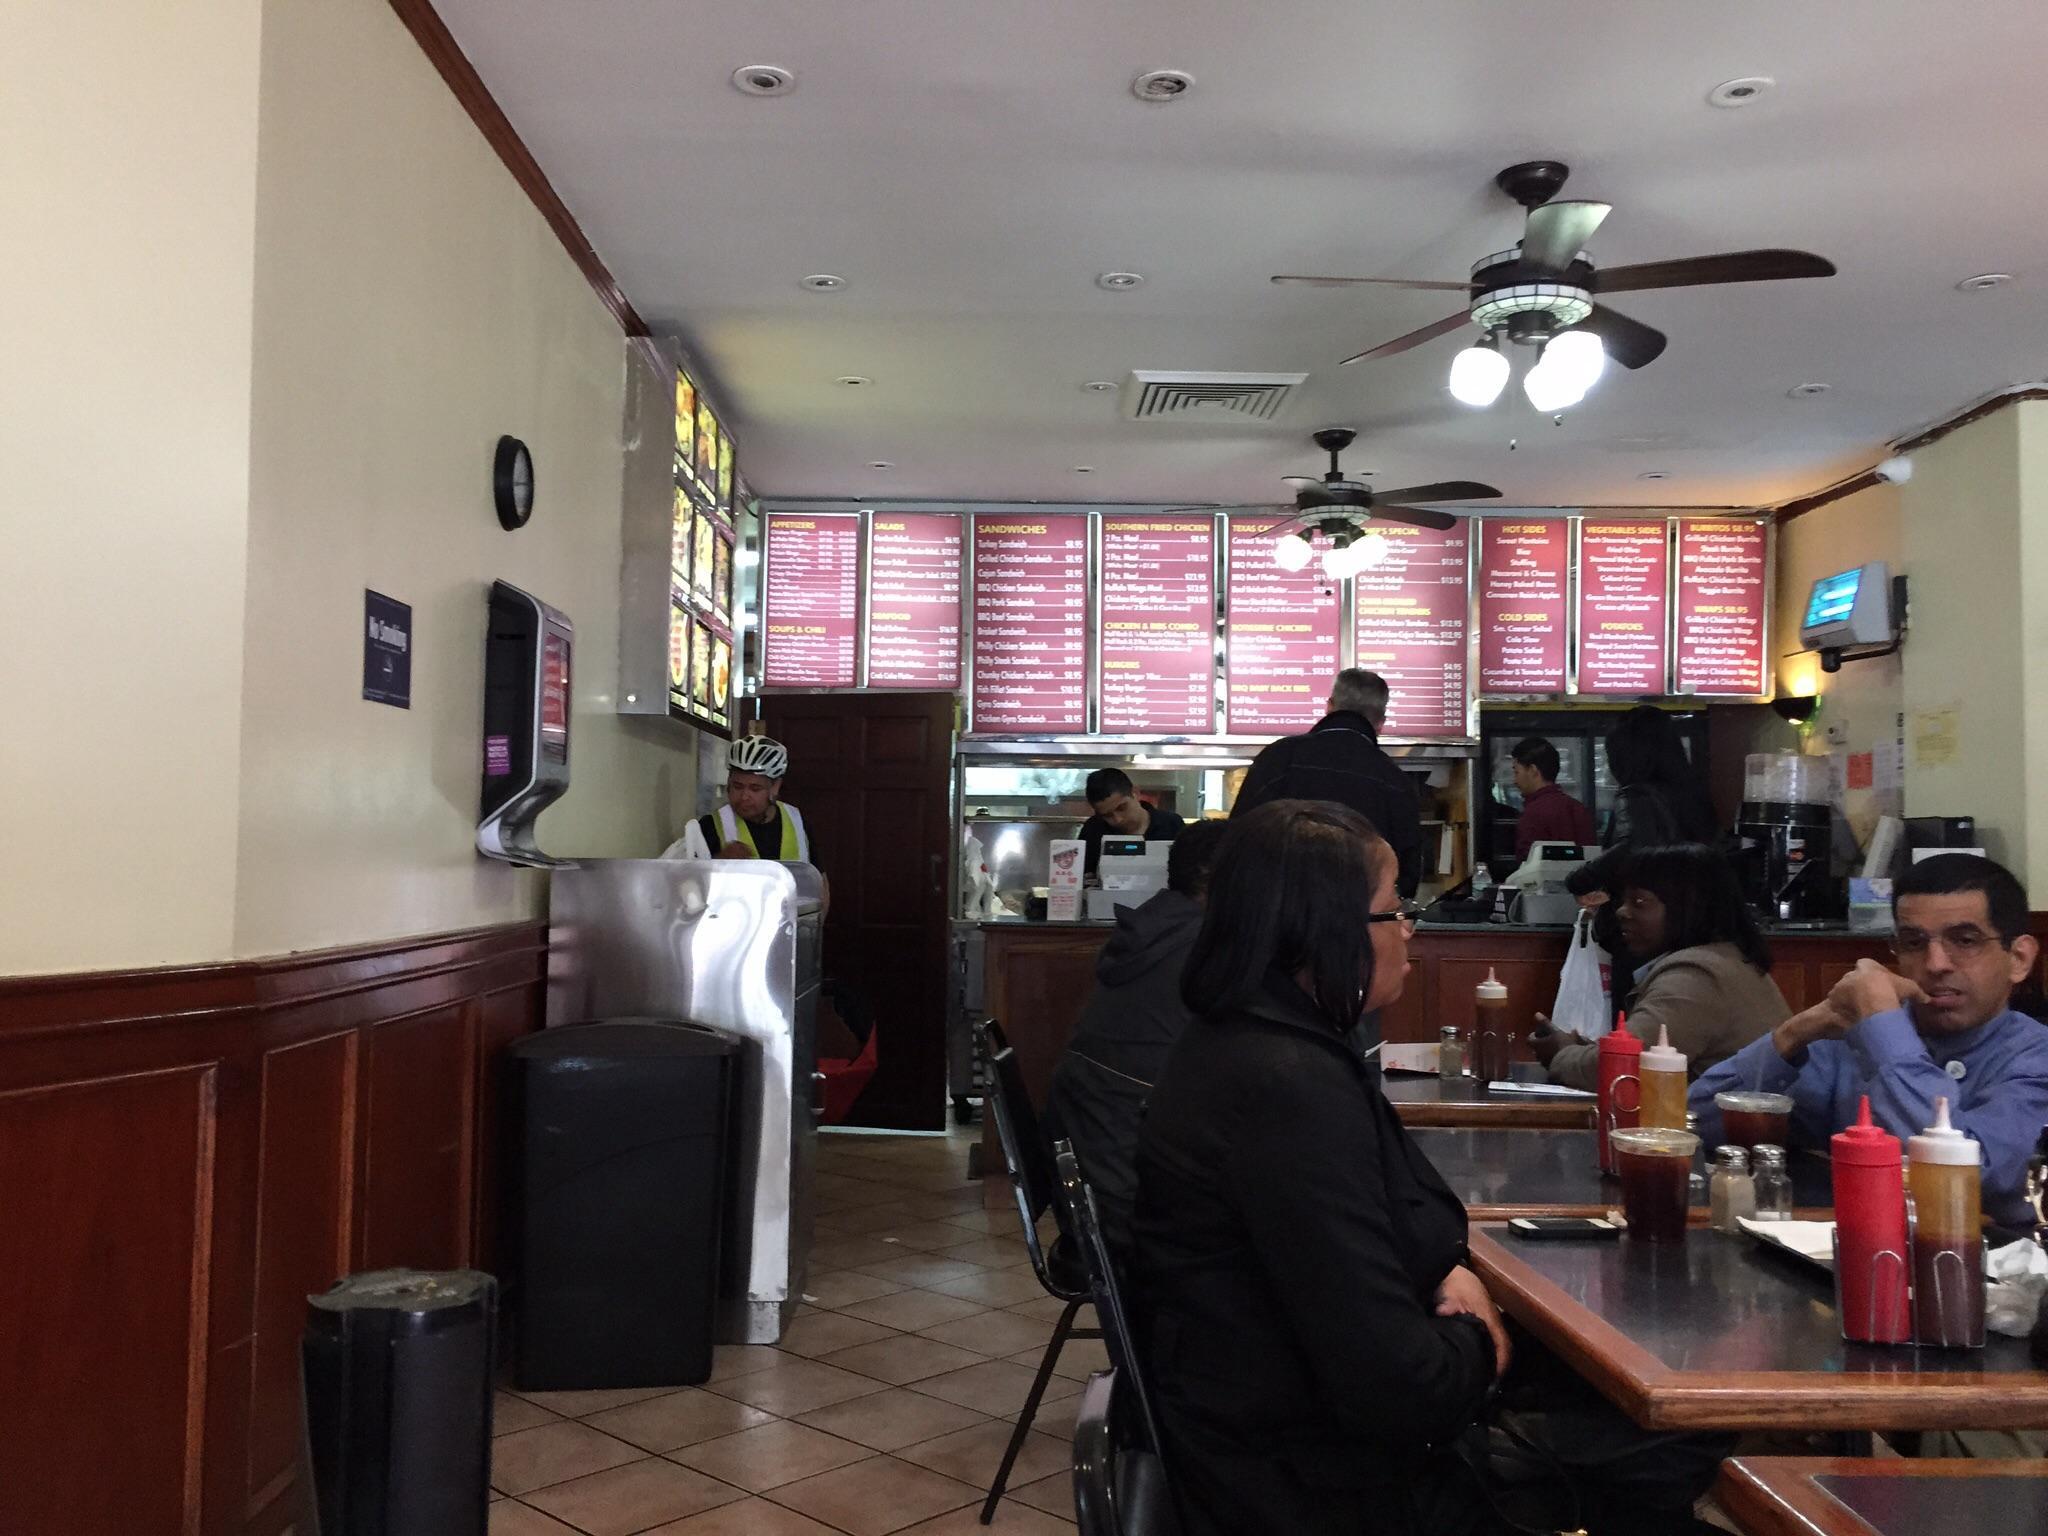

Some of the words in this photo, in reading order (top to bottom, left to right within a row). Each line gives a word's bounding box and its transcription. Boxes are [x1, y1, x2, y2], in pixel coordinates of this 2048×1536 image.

[978, 525, 1047, 534] SANDWICHES
[1105, 523, 1149, 531] SOUTHERN
[1150, 523, 1172, 531] FRIED
[1174, 523, 1210, 531] CHICKEN
[1000, 555, 1023, 563] Chicken
[1024, 555, 1053, 563] Sandwich
[992, 584, 1016, 592] Chicken
